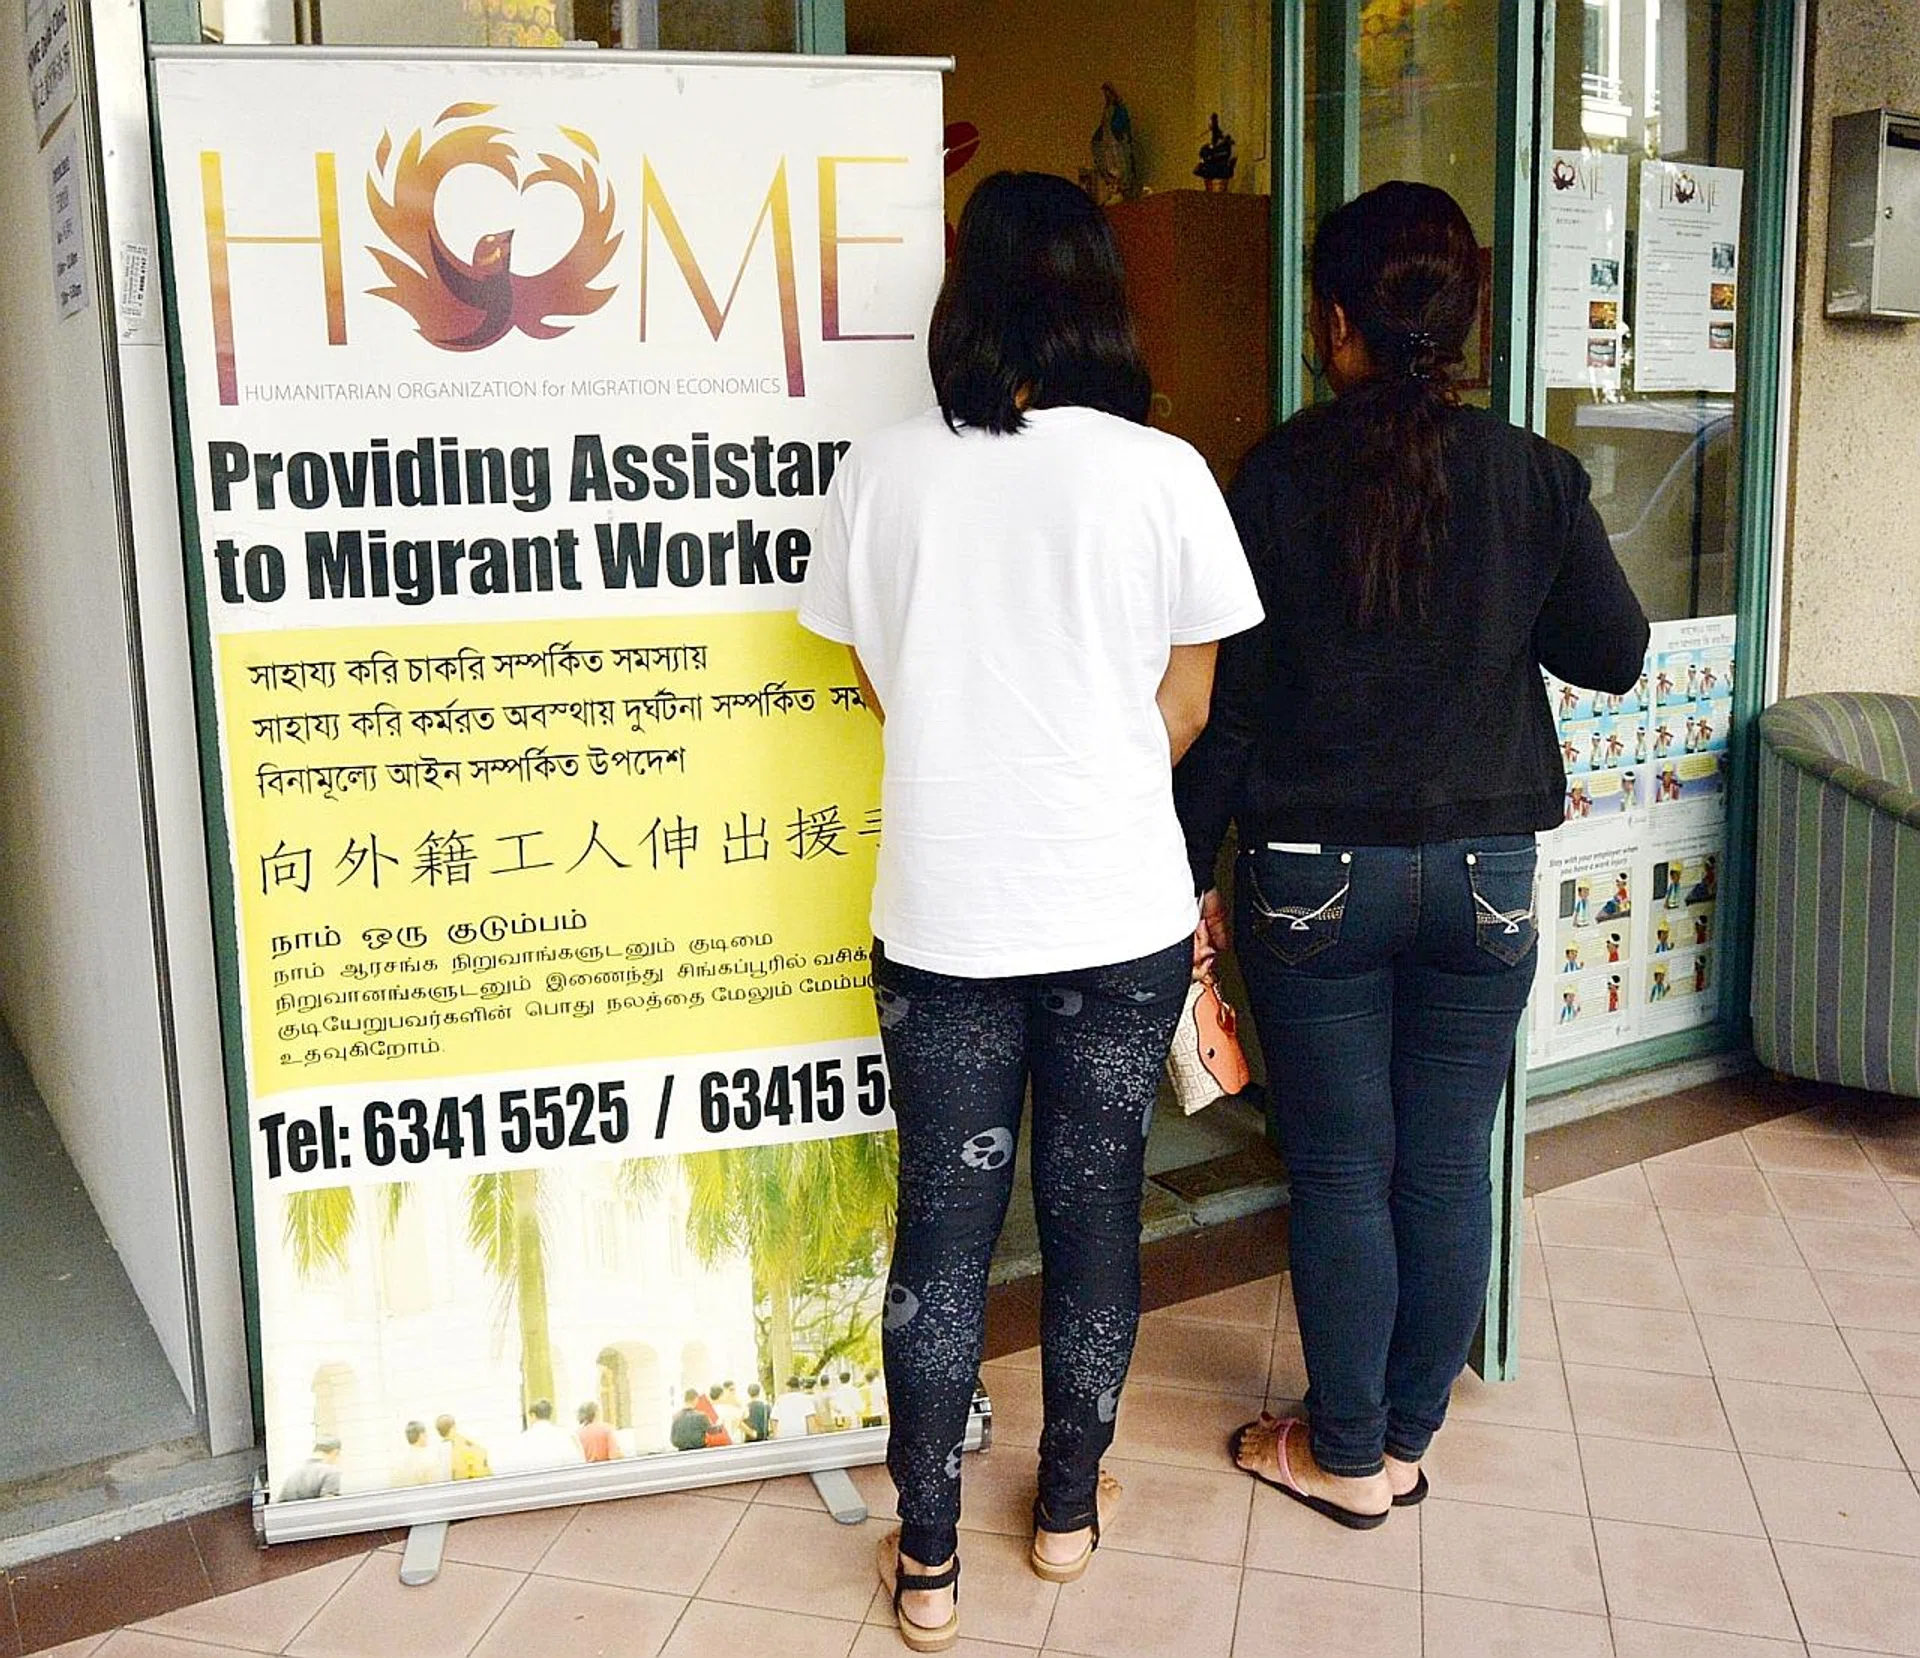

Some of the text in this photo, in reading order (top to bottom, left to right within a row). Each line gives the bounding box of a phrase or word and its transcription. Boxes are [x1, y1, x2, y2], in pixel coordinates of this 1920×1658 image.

[245, 378, 781, 403] HUMANITARIAN ORGANIZATION for MIGRATION ECONOMICS
[208, 436, 552, 513] Providing
[214, 519, 816, 606] to Migrant Worke
[247, 640, 708, 692] সাহায্য করি চাকরি সম্পর্কিত সমস্যায়
[252, 713, 341, 744] সাহায্য
[348, 702, 402, 738] করি
[409, 698, 496, 736] কর্মরত
[502, 700, 615, 729] অবস্থায়
[622, 688, 703, 733] দুর্ঘটনা
[712, 681, 816, 719] সম্পর্কিত
[256, 745, 686, 801] বিনামূল্যে আইন সম্পর্কিত উপদেশ
[271, 908, 588, 960] நாம் ஒரு குடும்பம்
[273, 961, 325, 988] நாம்
[688, 932, 774, 953] குடிமை
[545, 965, 664, 994] இணைந்து
[676, 953, 807, 980] சிங்கப்பூரில்
[813, 946, 876, 967] வசிக்
[525, 999, 594, 1019] பொது
[606, 991, 705, 1015] நலத்தை
[711, 980, 793, 1004] மேலும்
[259, 1054, 897, 1180] Tel: 6341 5525 / 63415 5
